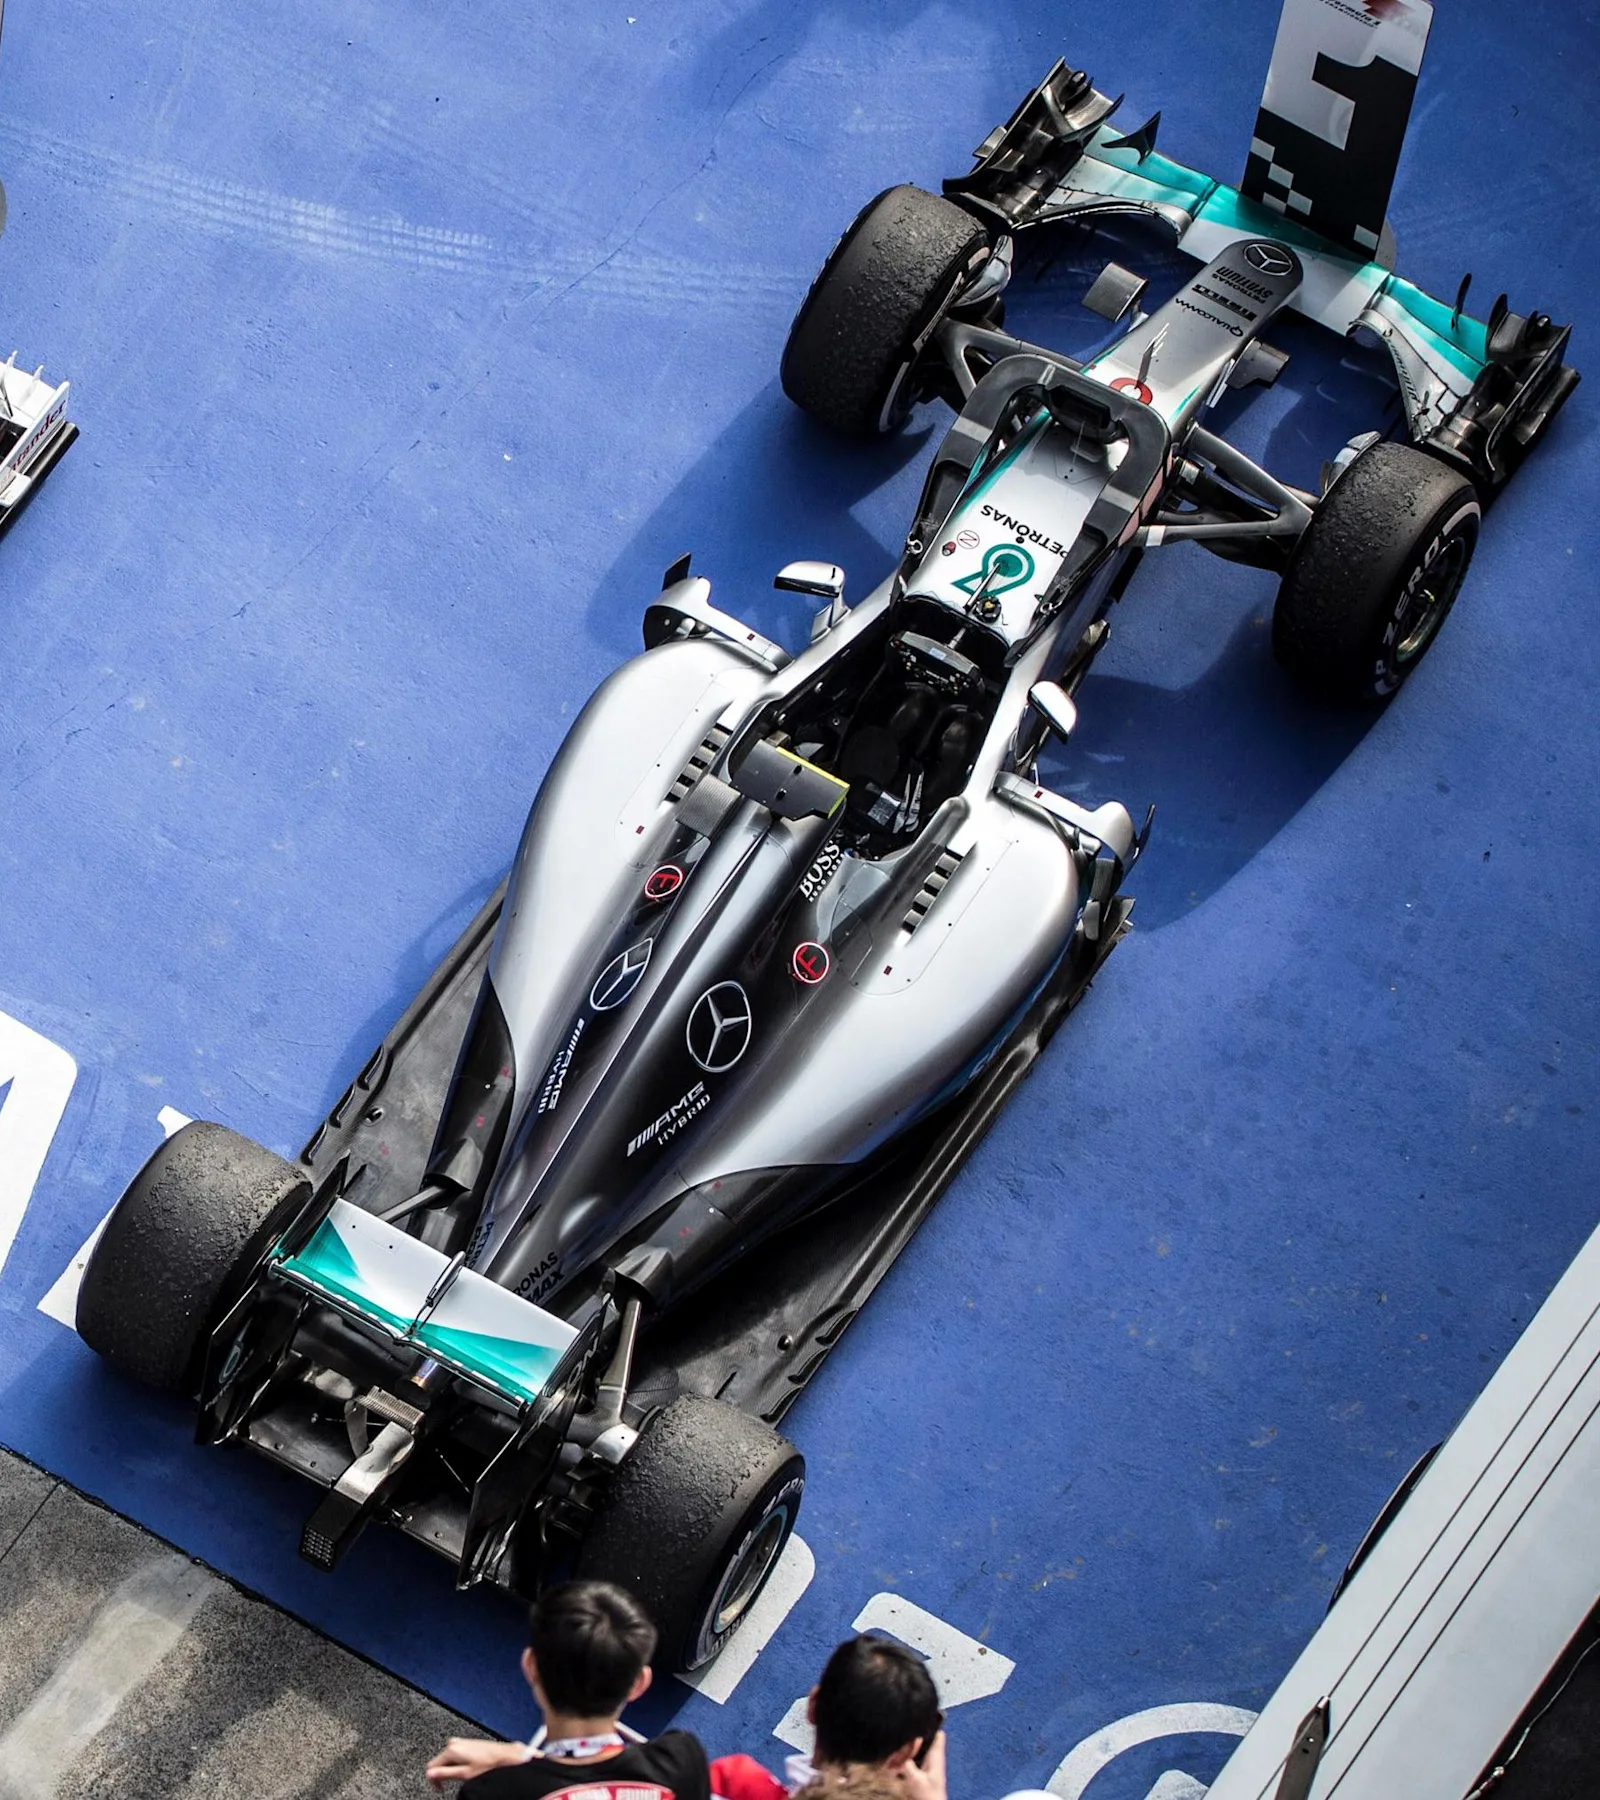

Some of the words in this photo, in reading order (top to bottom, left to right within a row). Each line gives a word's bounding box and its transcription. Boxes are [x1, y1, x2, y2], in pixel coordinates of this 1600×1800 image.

[1215, 265, 1274, 299] SYNTIUM
[11, 400, 66, 472] ntander
[1383, 536, 1440, 646] ZERO
[799, 840, 840, 898] BOSS
[657, 1094, 711, 1145] HYBRID
[470, 1221, 495, 1270] PETRO
[512, 1250, 559, 1298] RONAS
